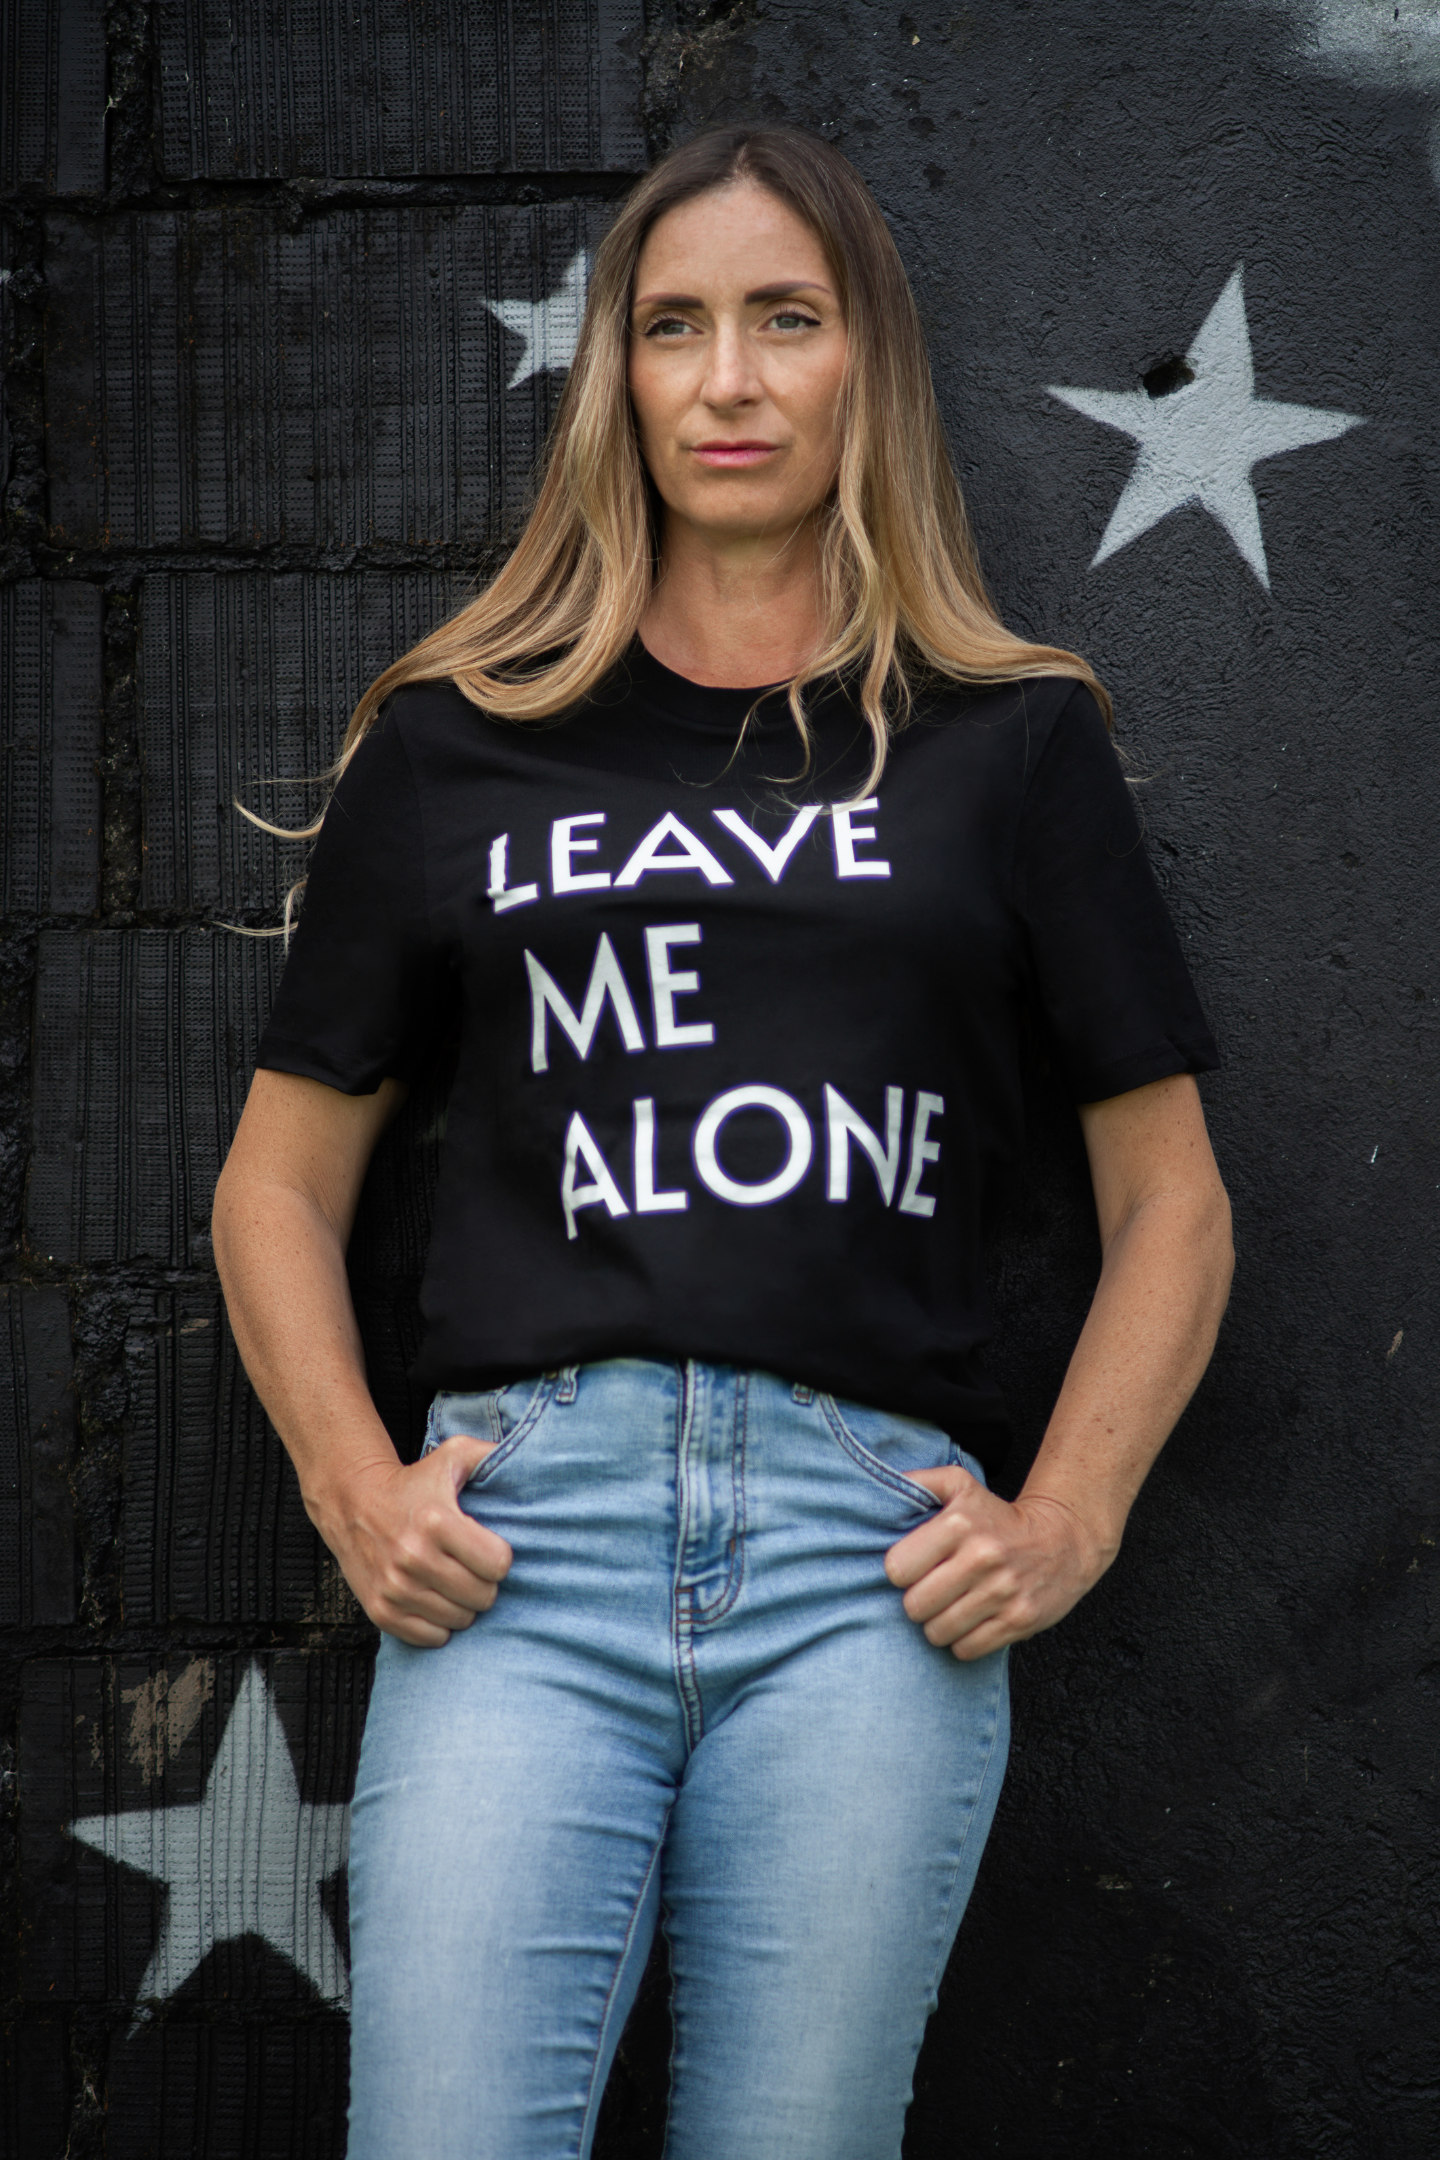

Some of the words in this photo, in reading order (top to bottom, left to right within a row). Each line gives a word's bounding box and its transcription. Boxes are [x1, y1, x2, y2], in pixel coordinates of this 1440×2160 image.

[486, 796, 892, 914] LEAVE
[523, 922, 716, 1074] ME
[560, 1082, 945, 1241] ALONE
